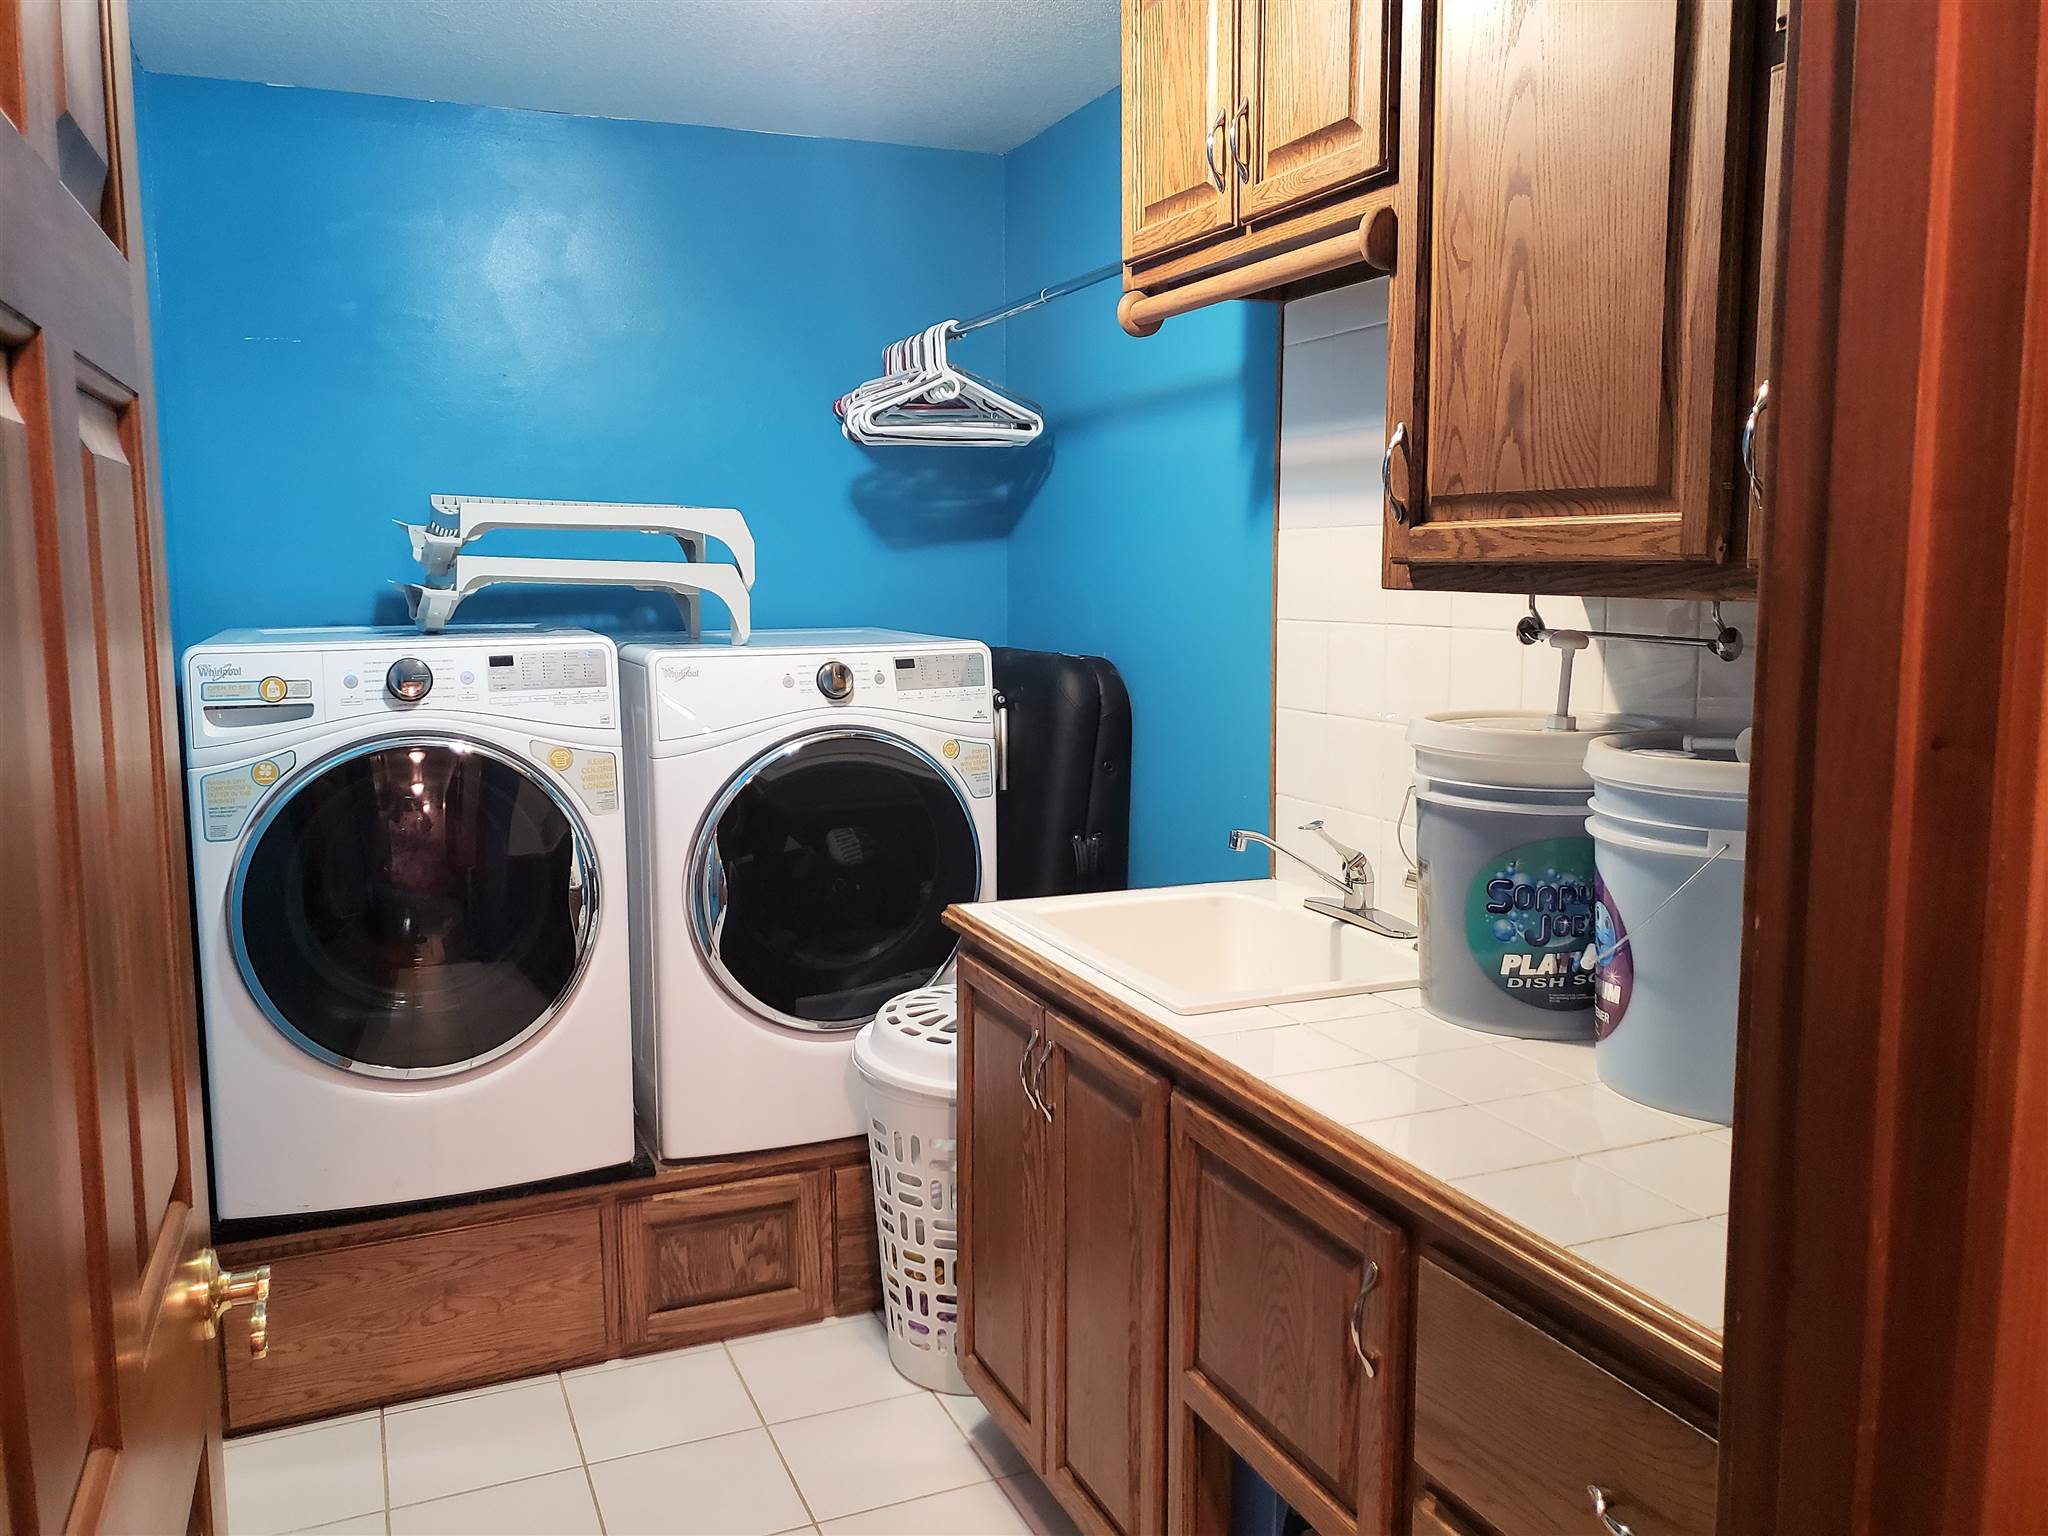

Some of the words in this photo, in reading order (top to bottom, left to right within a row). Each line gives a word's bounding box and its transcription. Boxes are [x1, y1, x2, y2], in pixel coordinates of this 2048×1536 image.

[197, 664, 242, 681] Whirlpool
[661, 664, 699, 682] Whirlpool
[1500, 950, 1583, 976] PLATI
[1507, 976, 1565, 988] DISH
